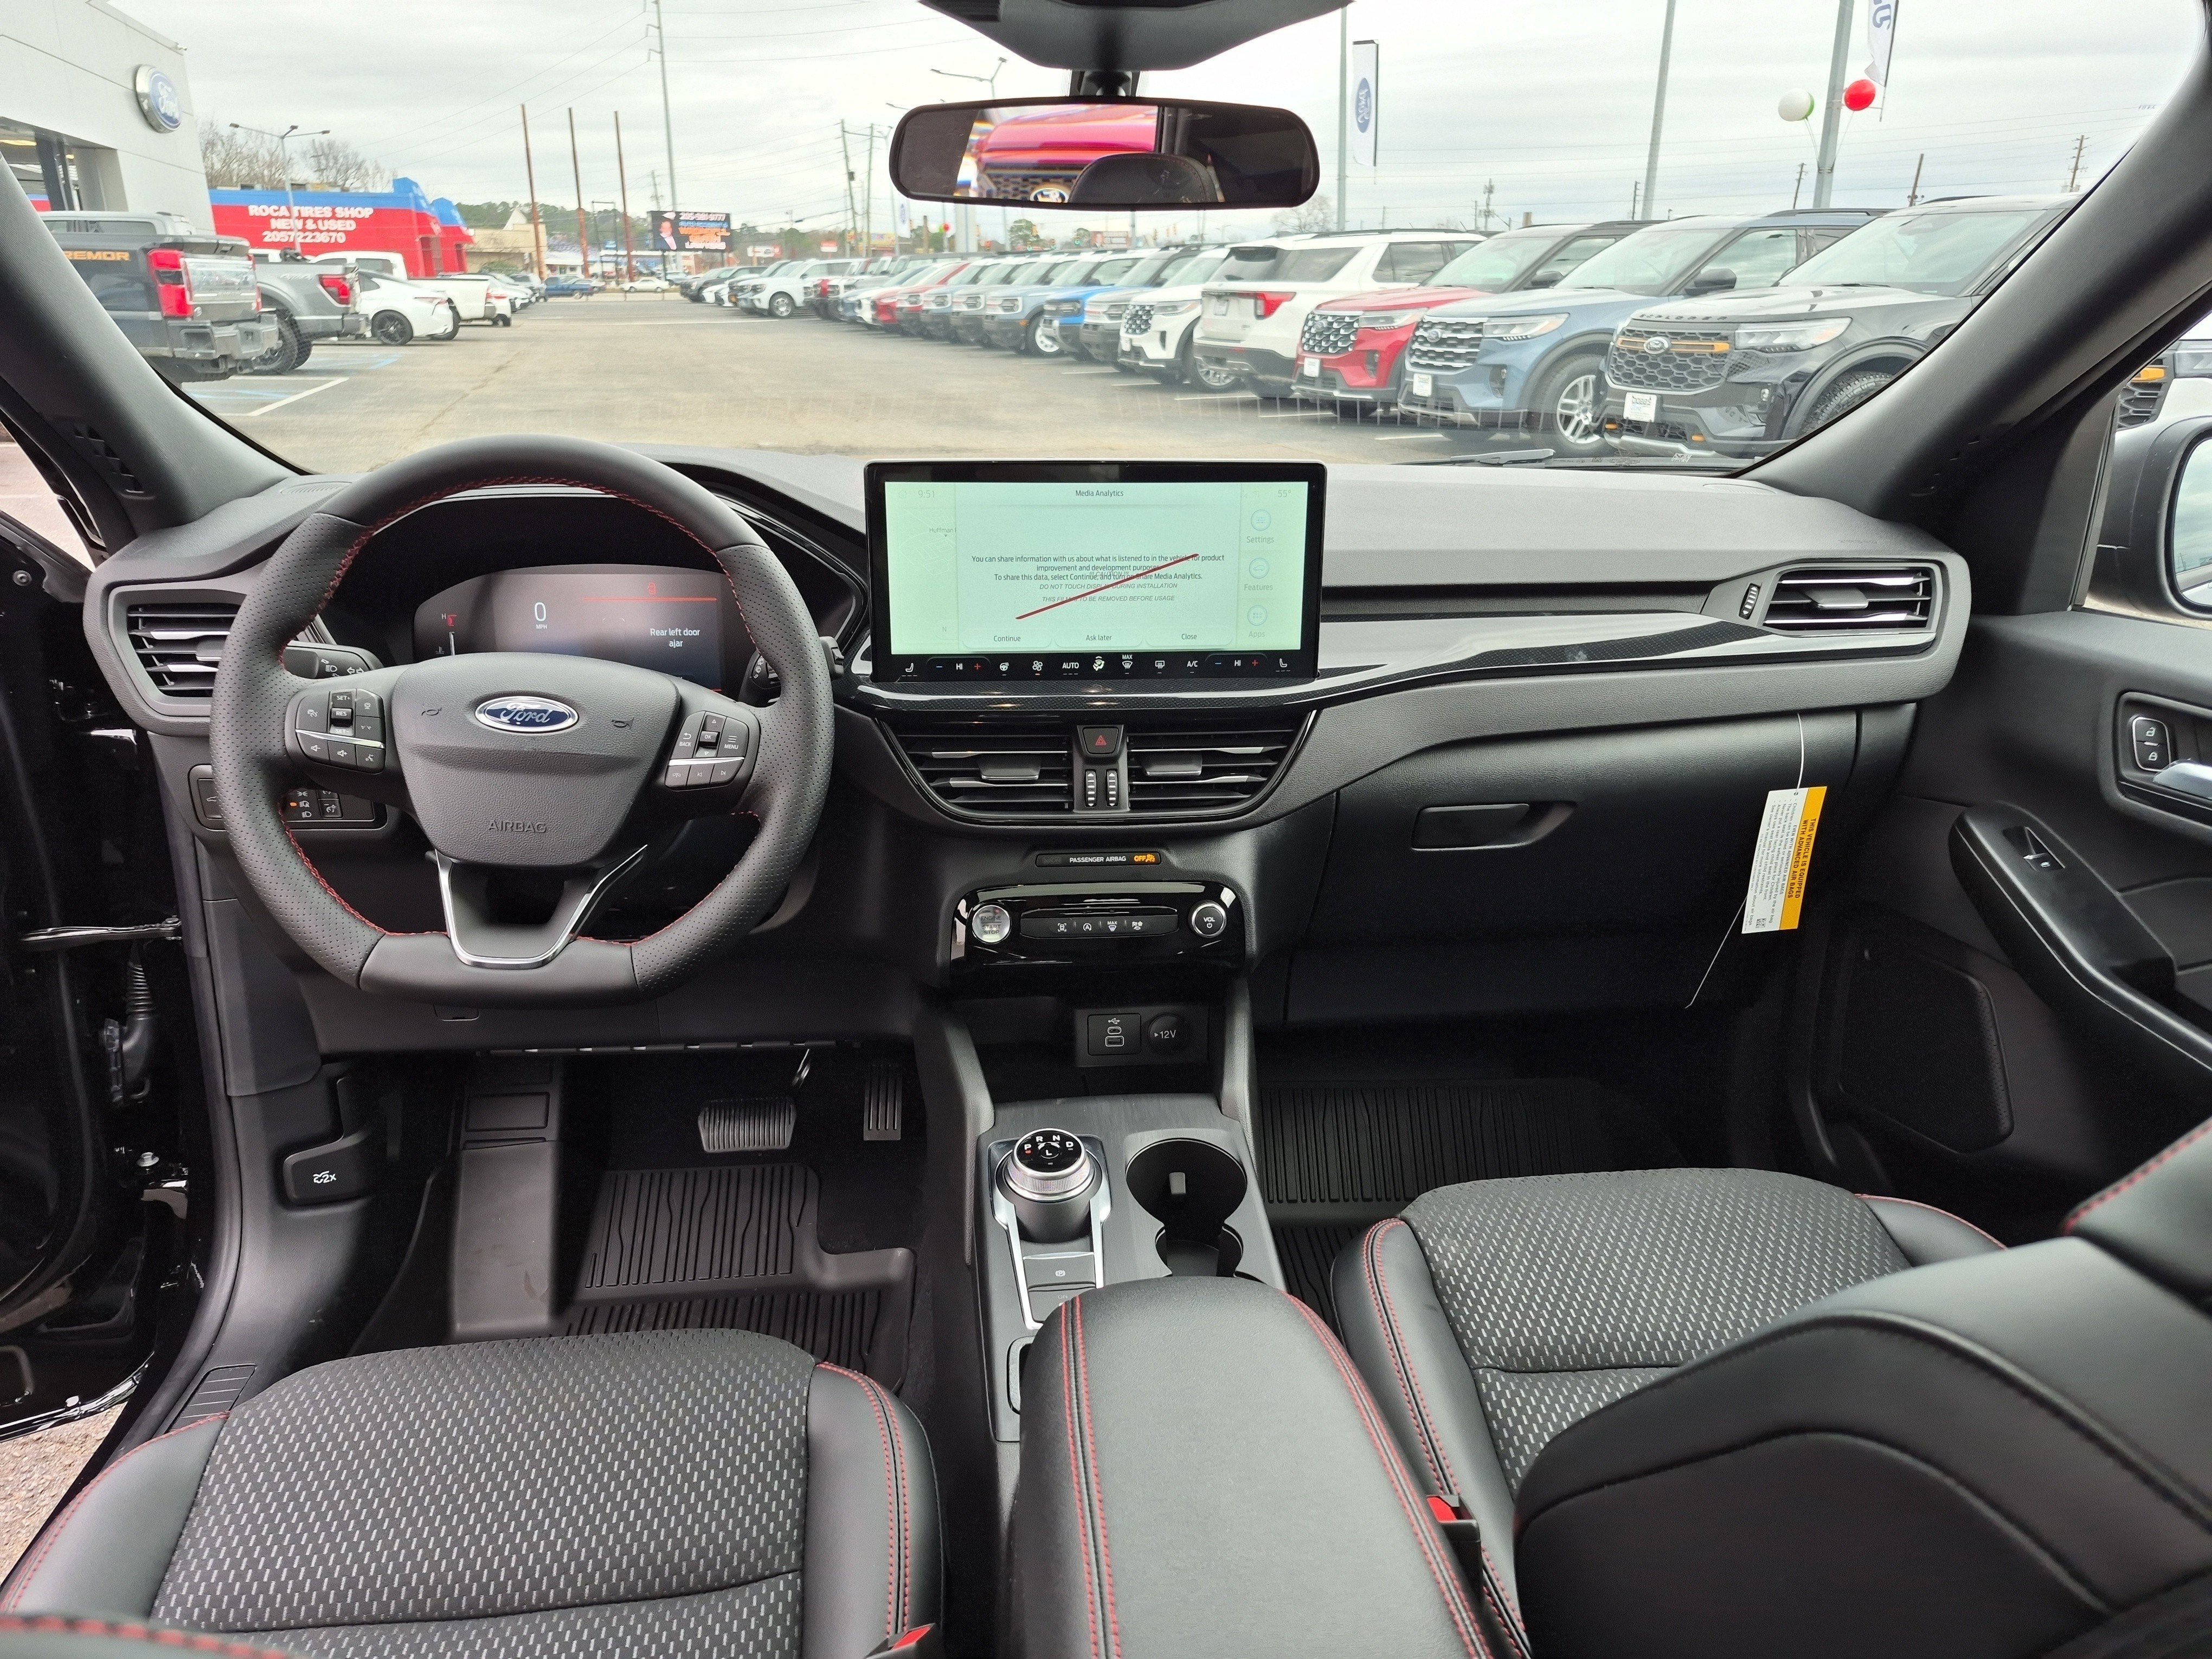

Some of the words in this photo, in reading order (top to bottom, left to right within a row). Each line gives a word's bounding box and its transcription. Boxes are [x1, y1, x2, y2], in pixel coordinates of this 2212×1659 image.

[248, 205, 290, 217] ROCA
[292, 206, 333, 217] TIRES
[335, 207, 374, 218] SHOP
[270, 218, 304, 230] NEW
[305, 218, 317, 230] &
[317, 219, 357, 231] USED
[63, 250, 130, 261] REMOR
[1095, 490, 1124, 498] Analytics
[1278, 490, 1291, 498] 55°
[534, 602, 547, 622] 0
[650, 628, 667, 637] Rear
[669, 628, 681, 636] left
[683, 628, 700, 636] door
[668, 639, 683, 648] ajar
[500, 702, 554, 723] Ford
[488, 820, 547, 834] AIRBAG
[1800, 819, 1808, 834] WITH
[1808, 818, 1816, 832] THIS
[1793, 837, 1804, 868] ADVANCED
[1802, 834, 1812, 859] VEHICLE
[1783, 850, 1791, 873] ADVANCED
[1786, 882, 1796, 898] BAGS
[1794, 868, 1805, 898] EQUIPPED
[1160, 1030, 1176, 1038] 12V
